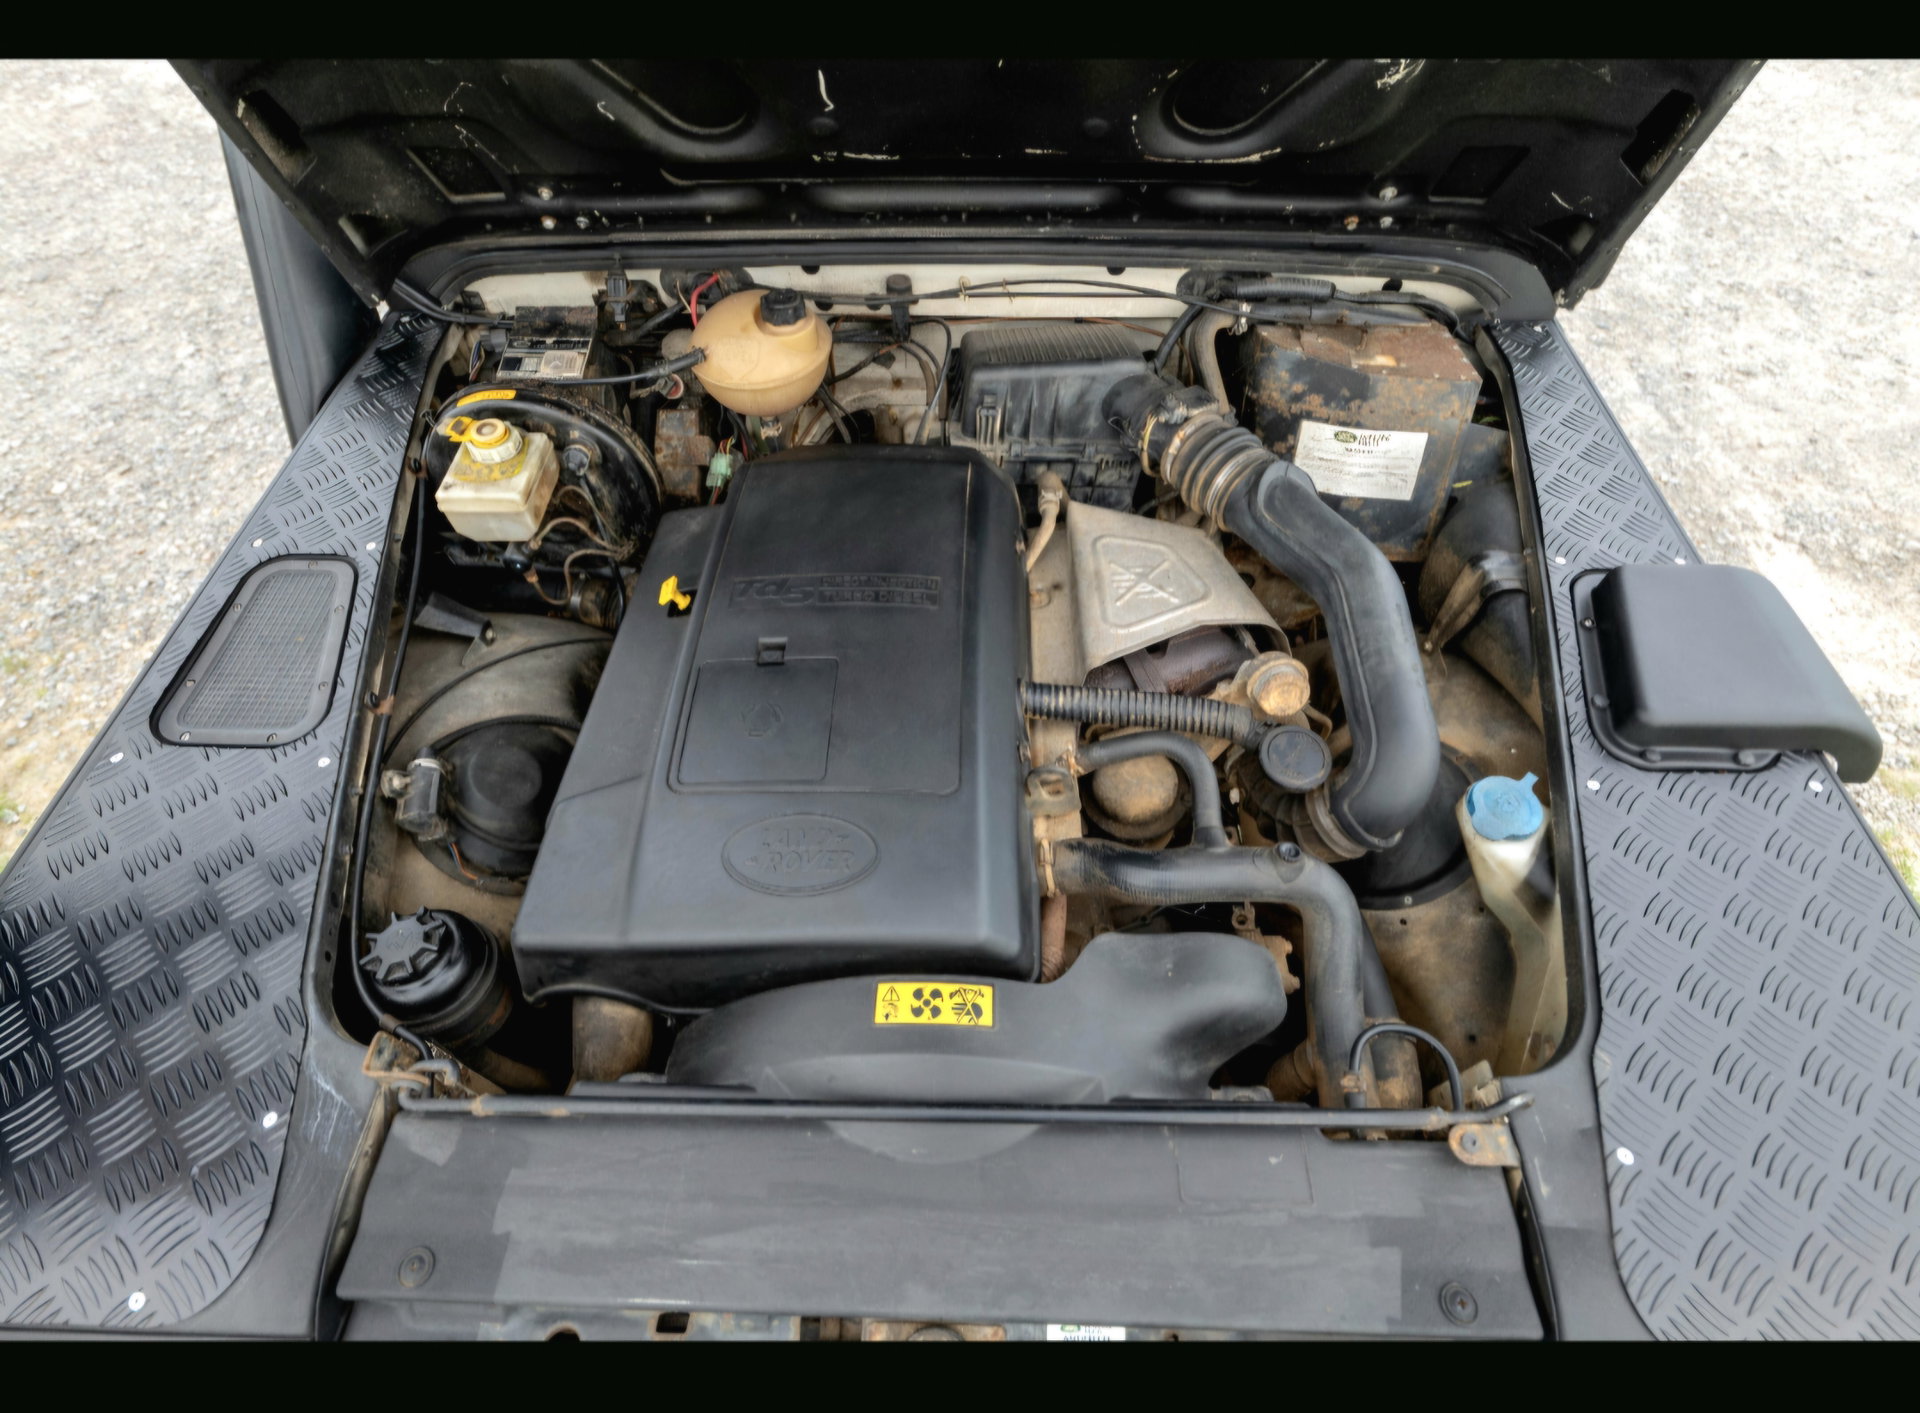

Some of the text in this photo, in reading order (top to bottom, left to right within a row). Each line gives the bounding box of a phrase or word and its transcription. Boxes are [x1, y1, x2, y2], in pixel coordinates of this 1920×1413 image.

[820, 576, 938, 589] DIRECT INJECTION
[823, 590, 931, 603] TURBO DIESEL
[767, 849, 856, 872] ROVER
